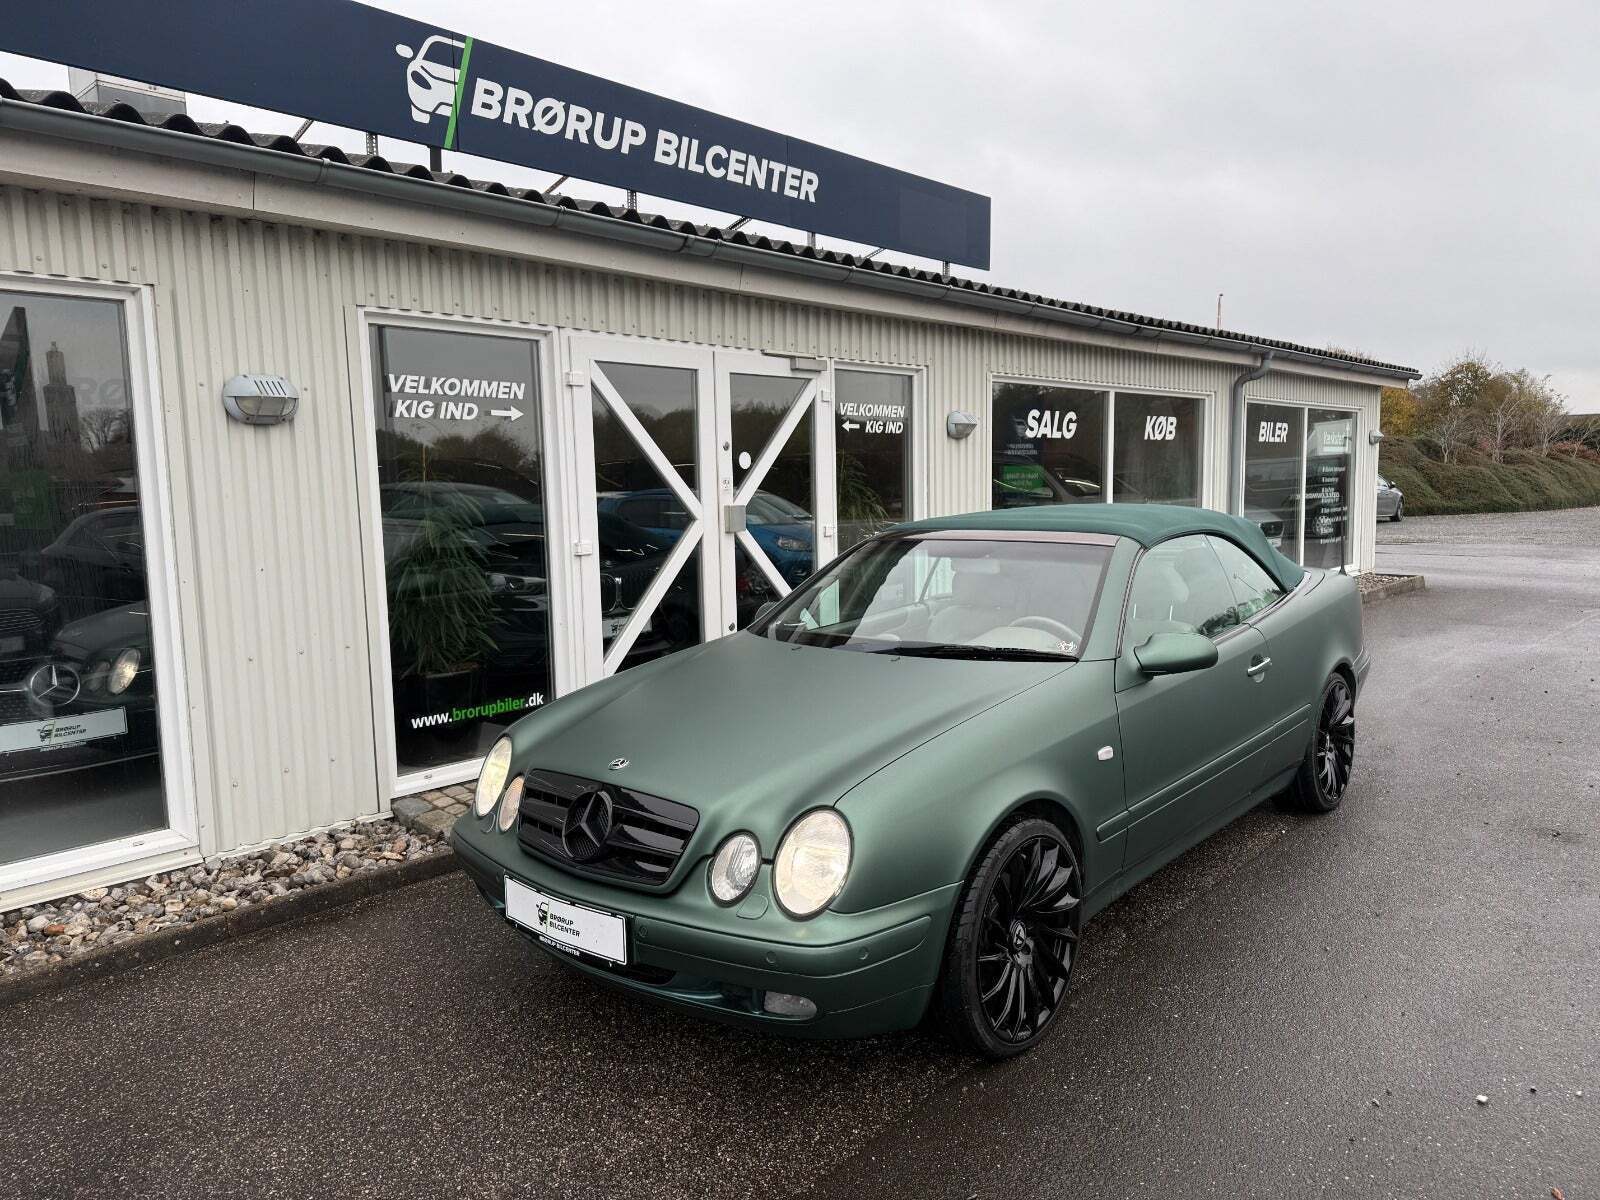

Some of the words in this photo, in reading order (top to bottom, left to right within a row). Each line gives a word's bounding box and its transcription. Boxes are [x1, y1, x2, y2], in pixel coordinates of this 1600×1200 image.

[470, 78, 647, 155] BRØRUP
[654, 129, 820, 203] BILCENTER
[388, 373, 526, 400] VELKOMMEN
[394, 399, 435, 419] KIG
[439, 401, 479, 420] IND
[840, 402, 905, 418] VELKOMMEN
[865, 420, 884, 433] KIG
[885, 421, 904, 434] IND
[1025, 408, 1078, 440] SALG
[1144, 415, 1177, 441] KØB
[1258, 421, 1289, 443] BILER
[411, 692, 544, 729] www.brorupbiler.dk
[549, 913, 574, 926] BRØRUP
[549, 921, 580, 937] BILCENTER
